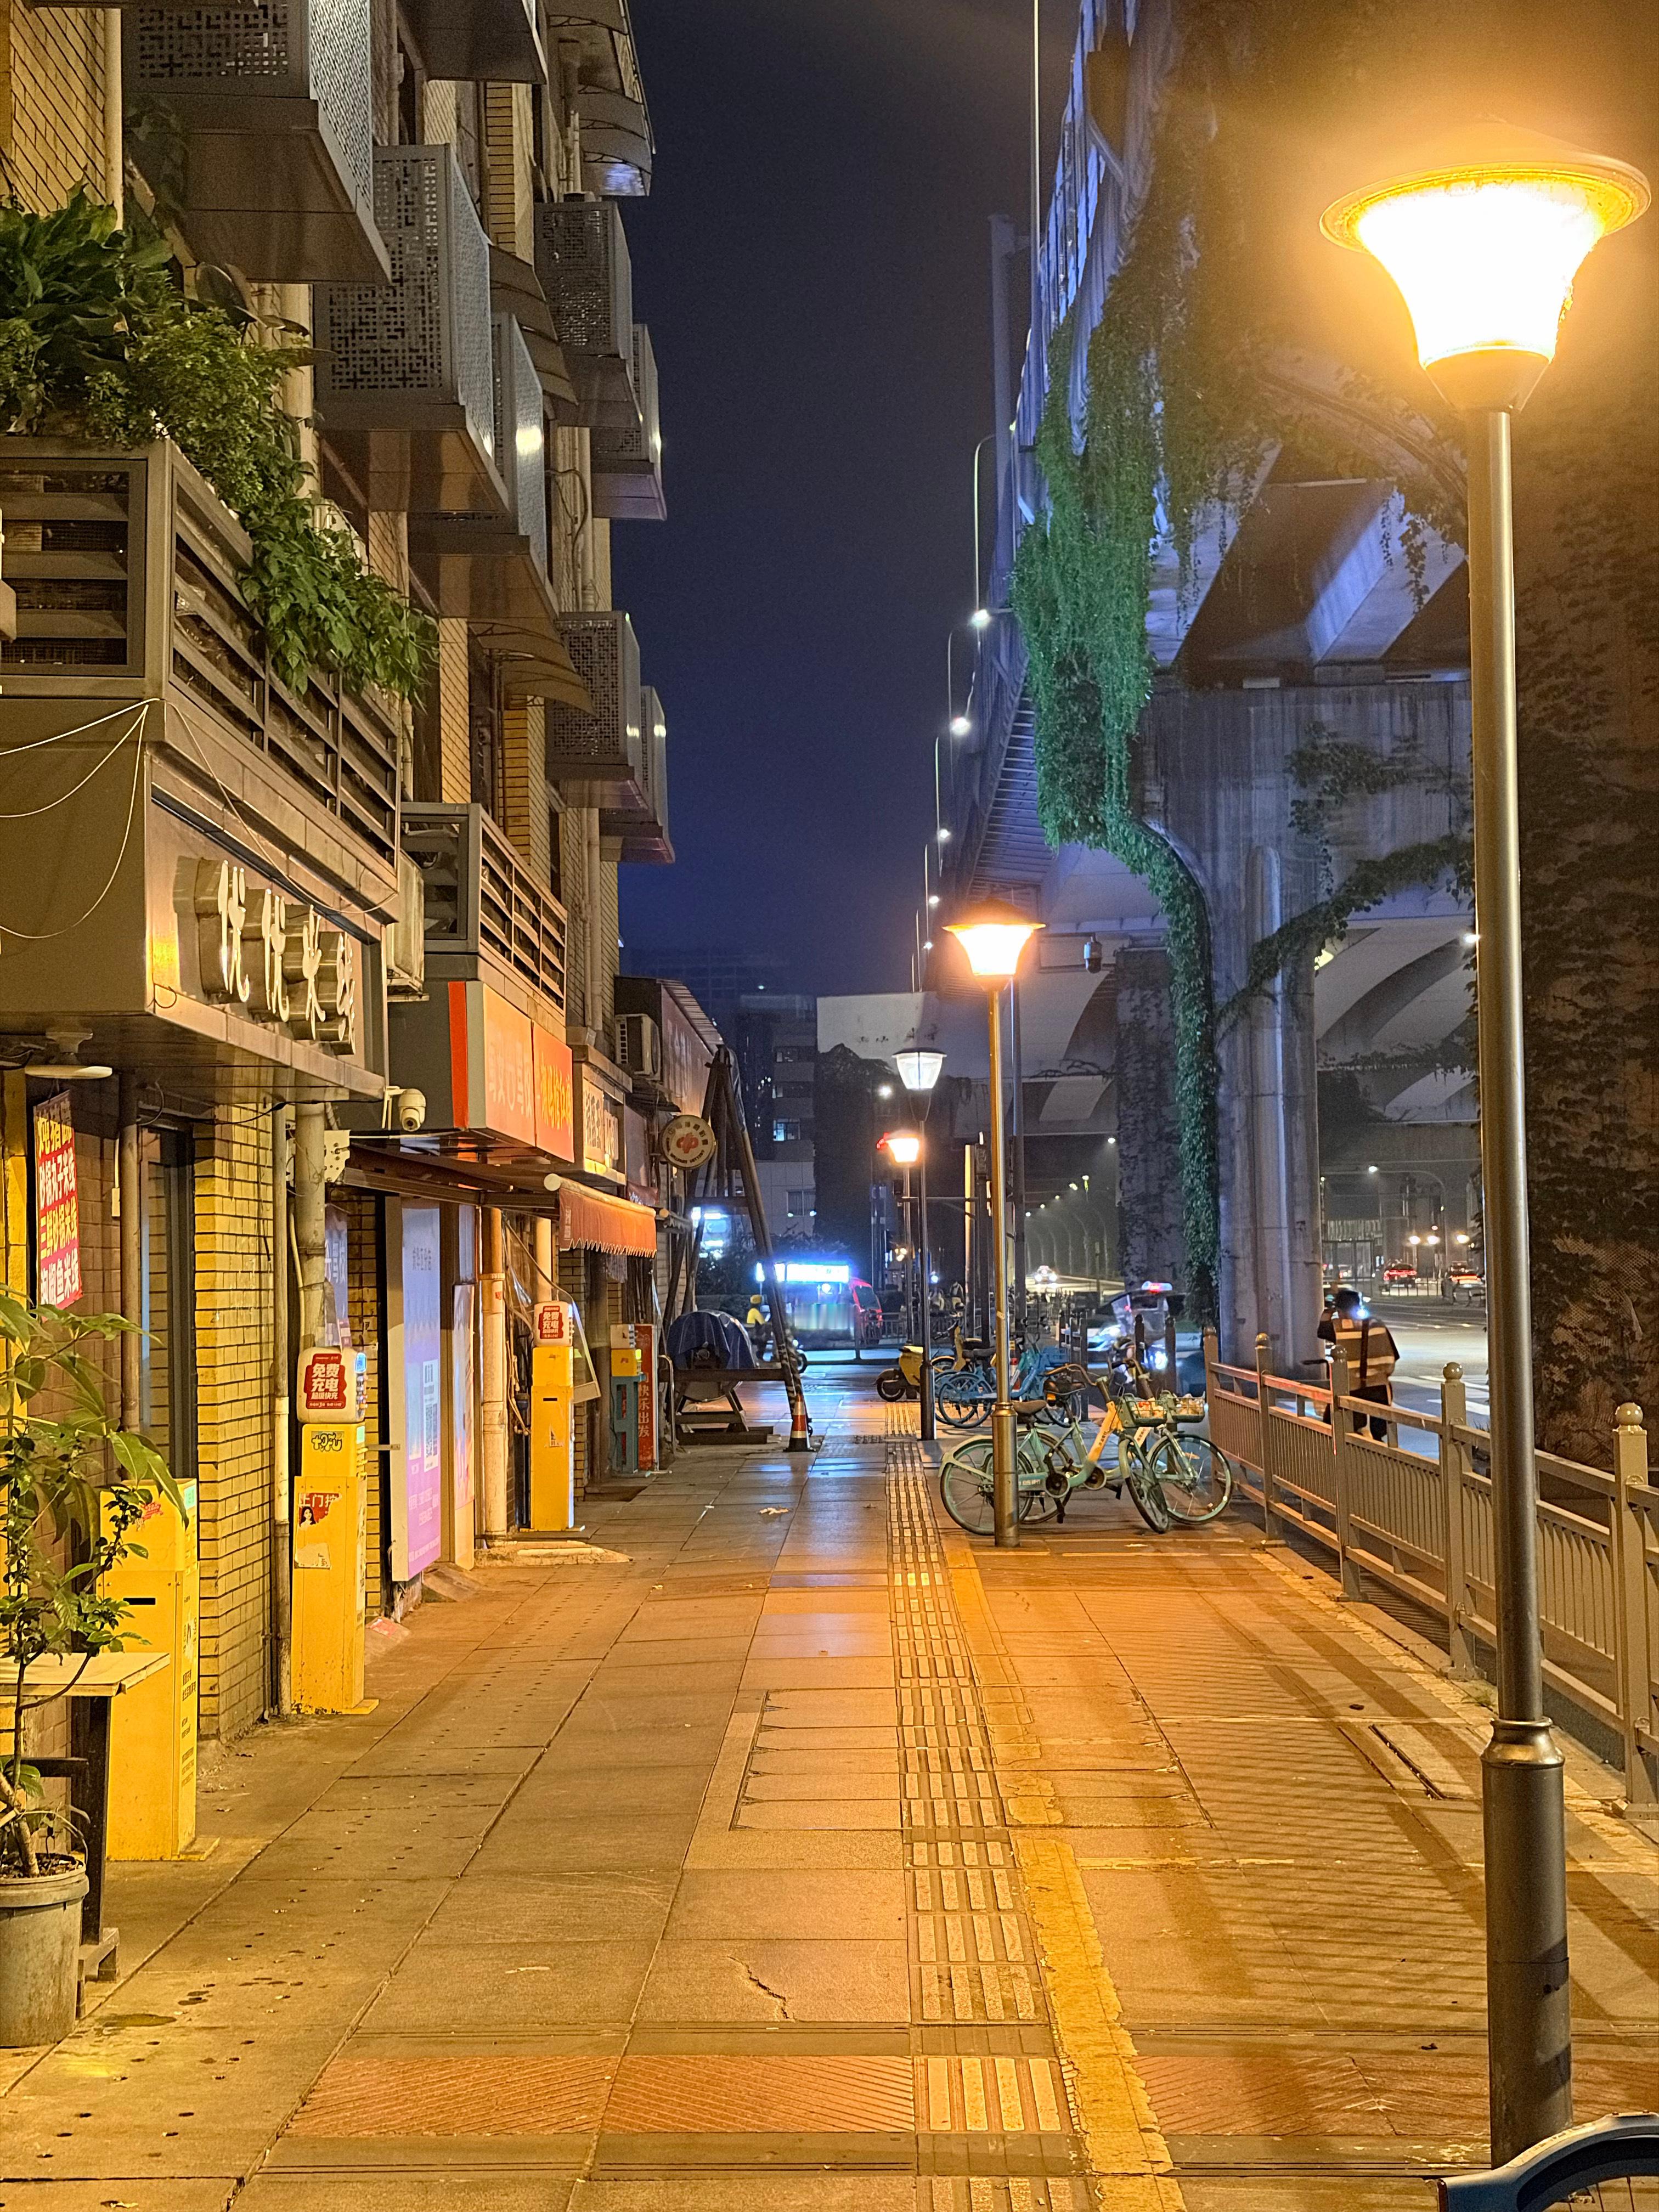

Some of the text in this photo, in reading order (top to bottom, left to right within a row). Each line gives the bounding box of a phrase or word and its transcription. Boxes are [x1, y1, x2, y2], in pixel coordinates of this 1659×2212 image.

[218, 860, 356, 1055] 优优米线
[40, 1147, 76, 1210] 砂锅丸子米线
[41, 1200, 77, 1257] 三鲜砂锅米线
[311, 1378, 339, 1392] 充电
[312, 1363, 340, 1378] 免费
